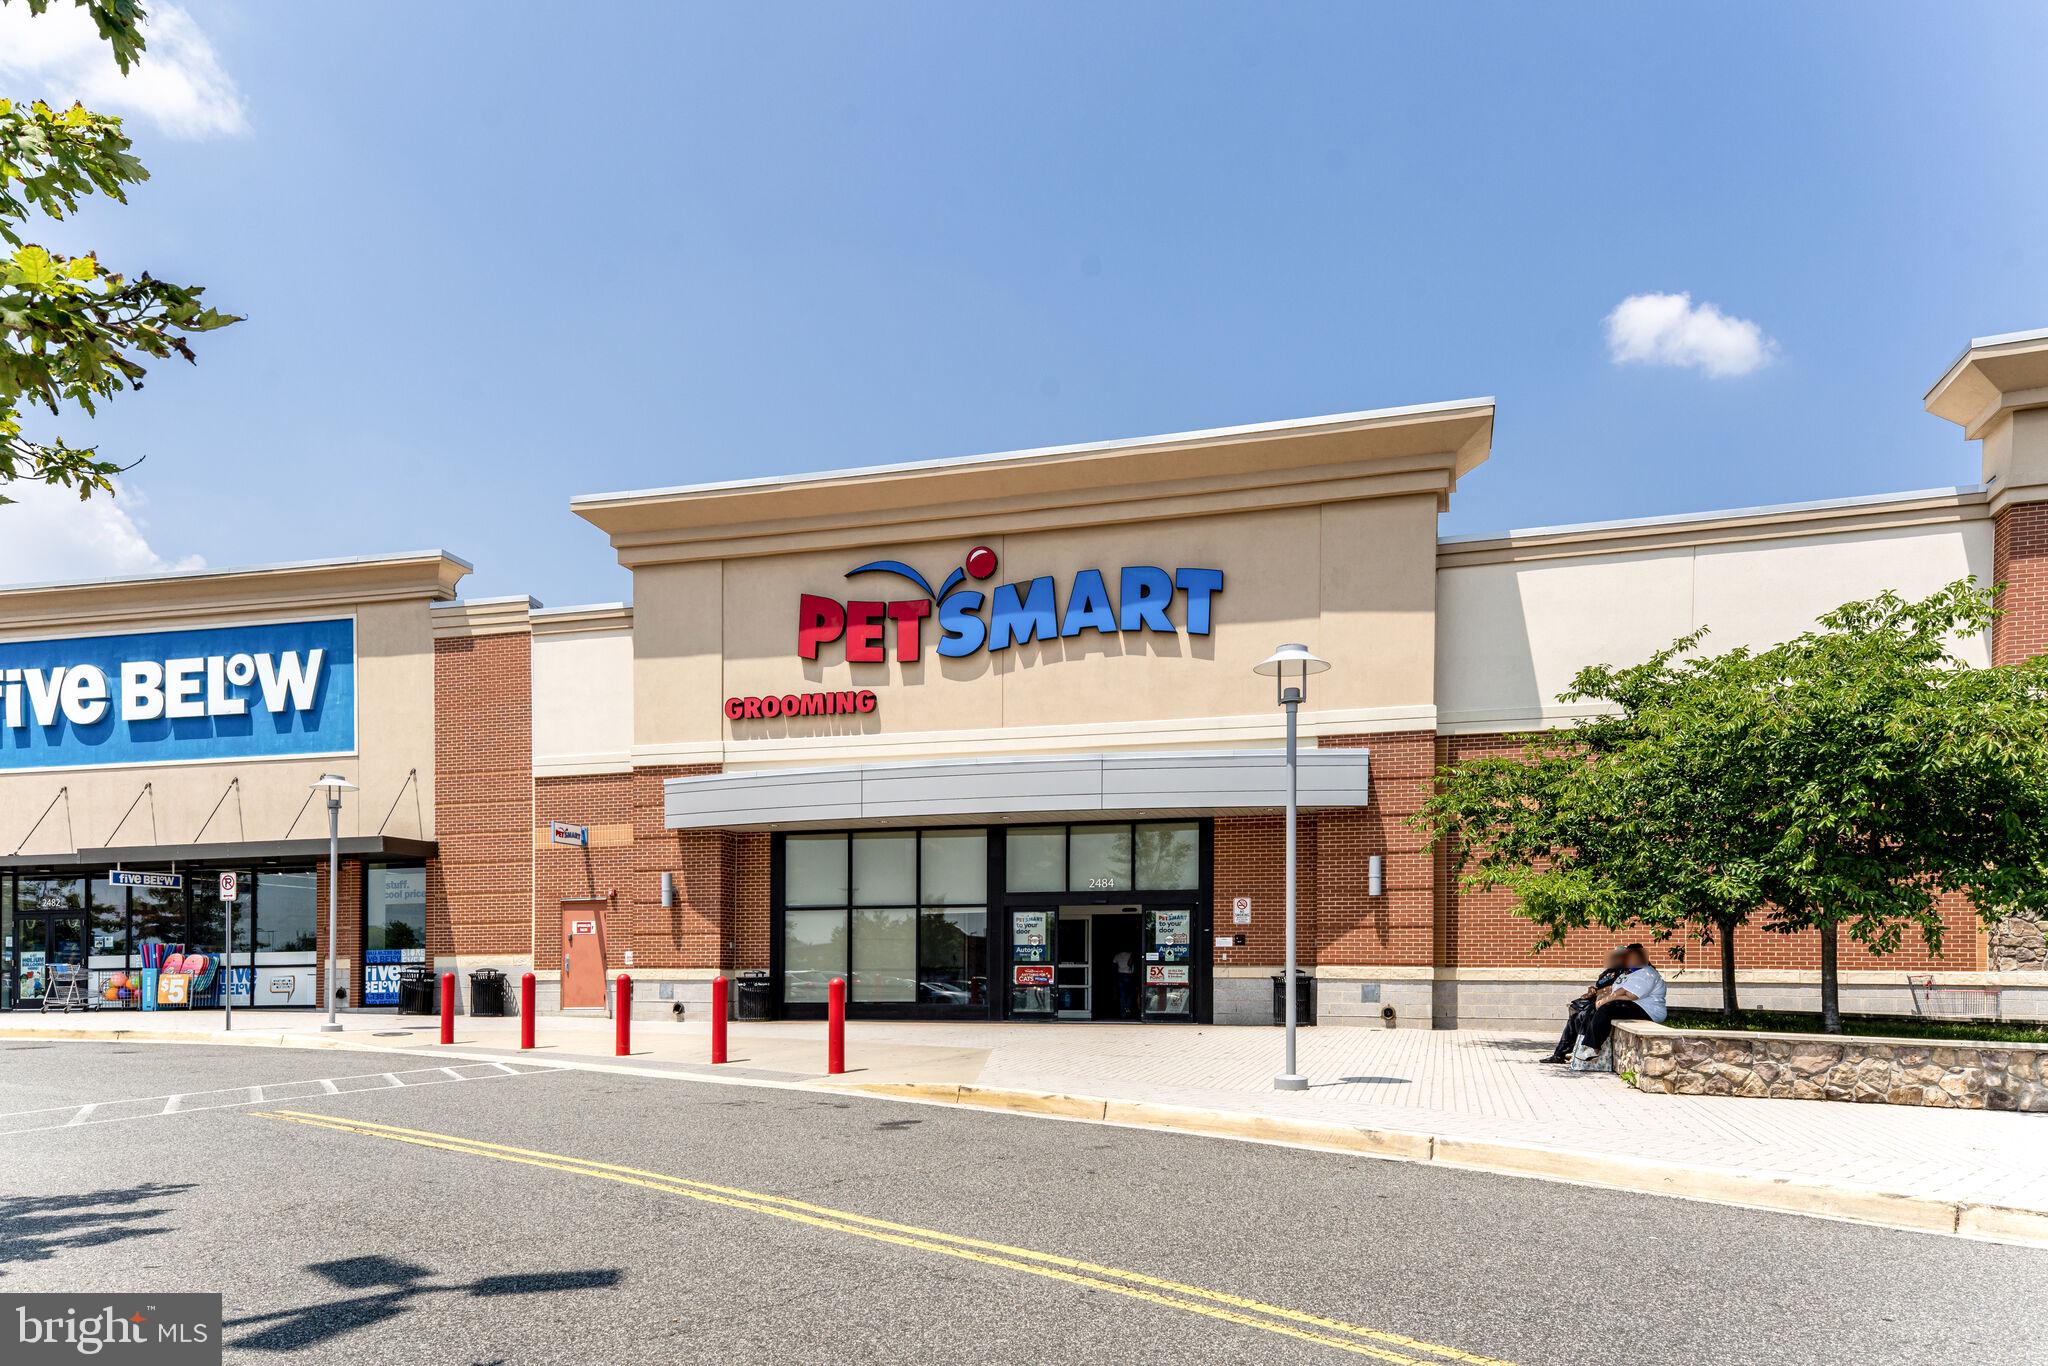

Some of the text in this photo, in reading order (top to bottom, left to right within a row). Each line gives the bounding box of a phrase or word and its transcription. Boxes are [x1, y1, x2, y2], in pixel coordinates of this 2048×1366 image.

[0, 648, 326, 728] ive BELOW
[724, 689, 877, 720] GROOMING
[119, 873, 174, 886] five BELOW
[384, 880, 410, 889] stuff.
[1089, 878, 1115, 889] 2484
[42, 898, 61, 907] 2482
[1150, 966, 1165, 976] 5X
[161, 978, 184, 1004] $5
